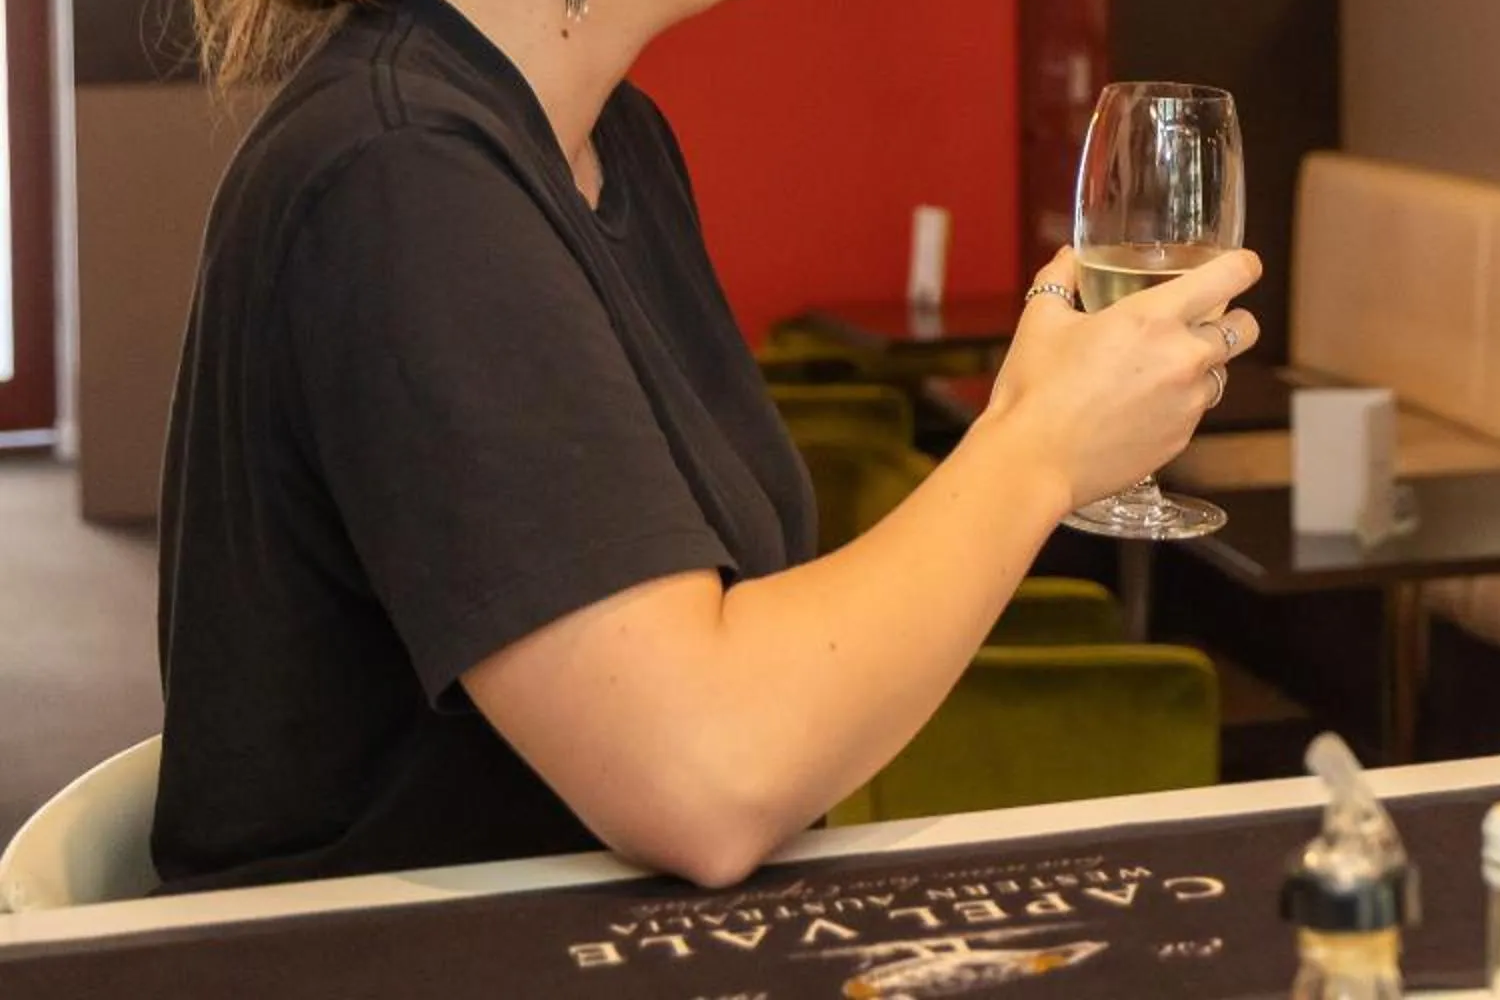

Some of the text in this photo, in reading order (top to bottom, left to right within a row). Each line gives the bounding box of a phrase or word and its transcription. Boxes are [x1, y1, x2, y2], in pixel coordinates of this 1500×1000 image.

[887, 875, 1227, 929] CAPEL
[925, 865, 1154, 902] WESTERN
[608, 892, 895, 936] AUSTRALIA
[567, 918, 860, 969] VALE
